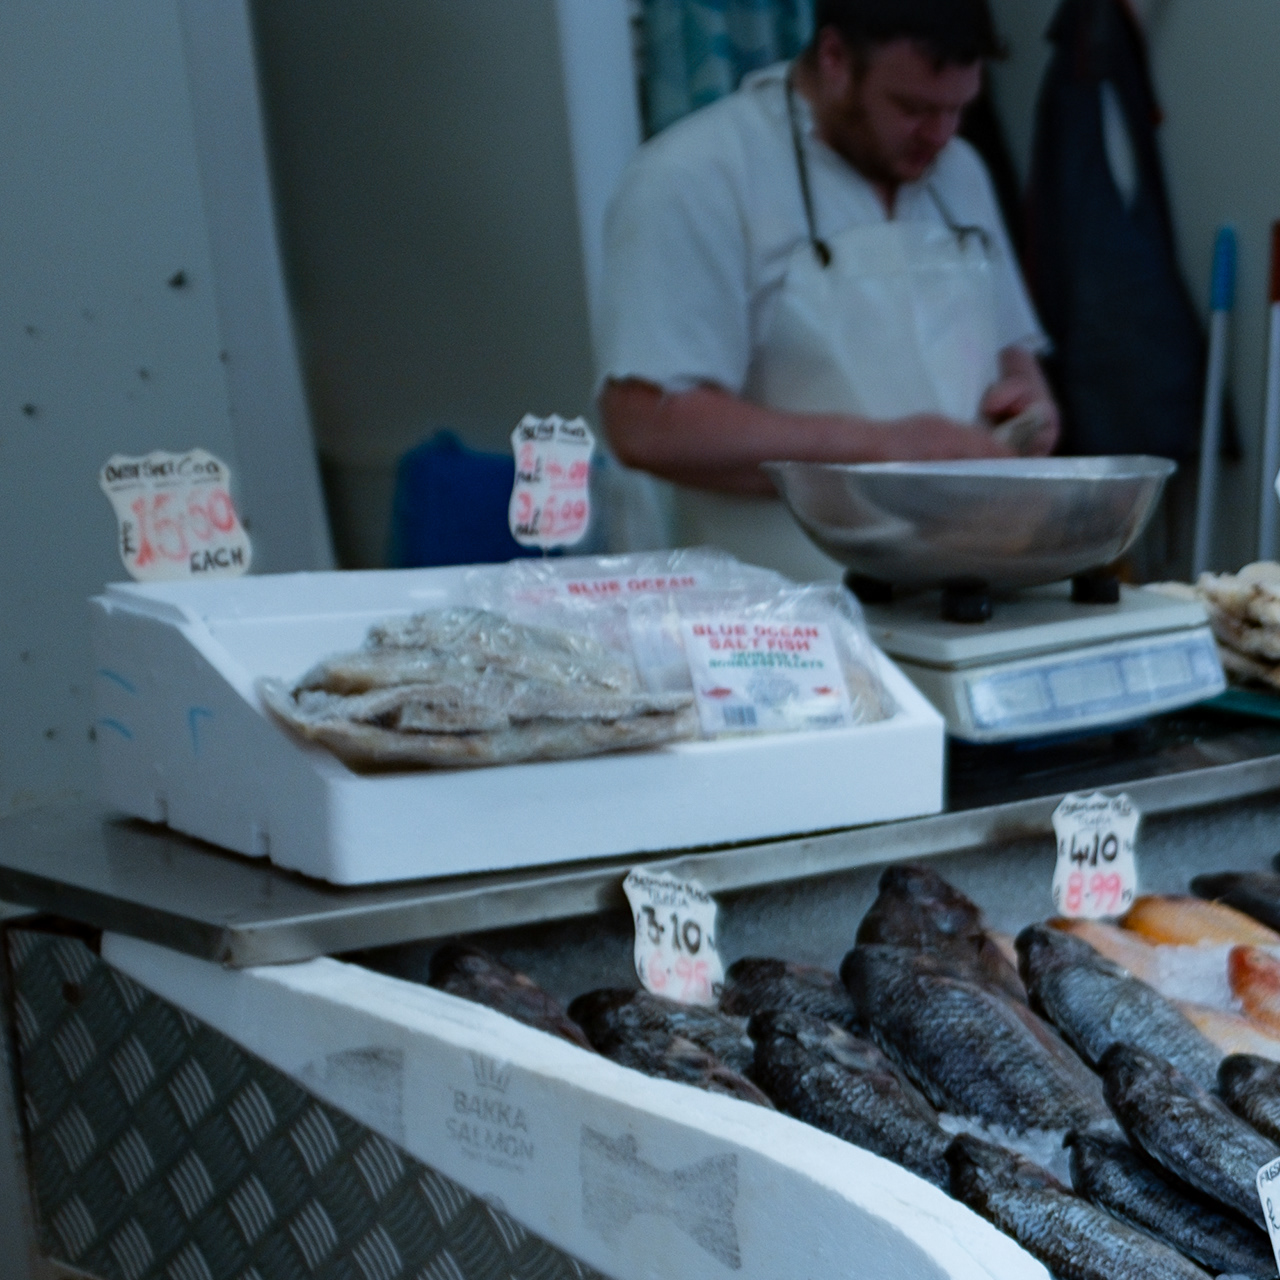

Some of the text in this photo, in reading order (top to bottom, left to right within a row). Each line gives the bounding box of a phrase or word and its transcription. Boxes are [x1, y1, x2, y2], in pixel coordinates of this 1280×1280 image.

[190, 547, 243, 572] EACH
[567, 580, 621, 597] BLUE
[627, 575, 695, 593] OCEAN
[693, 623, 818, 638] BLUE OCEAN
[709, 637, 810, 651] SALT FISH
